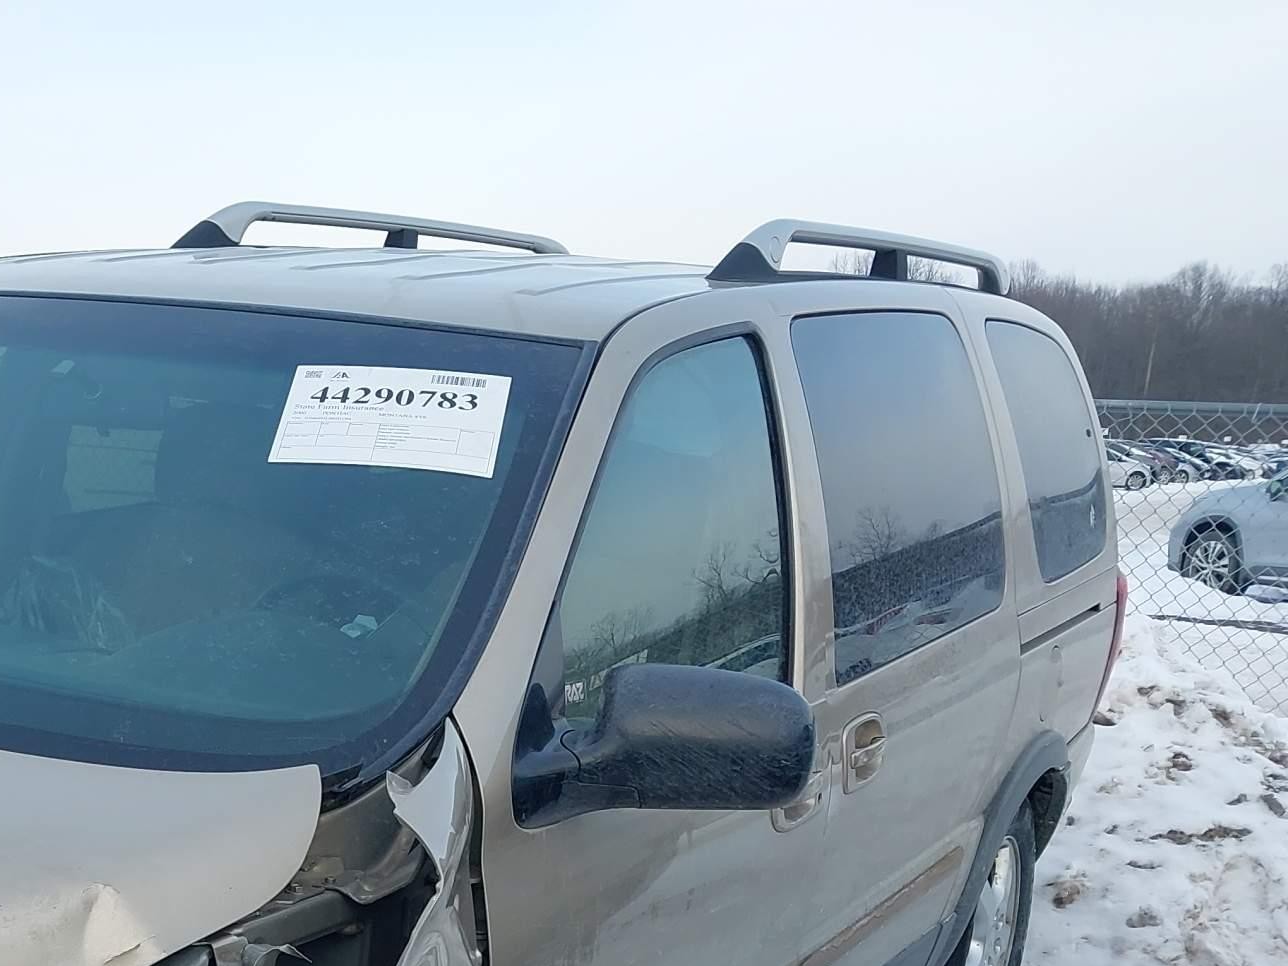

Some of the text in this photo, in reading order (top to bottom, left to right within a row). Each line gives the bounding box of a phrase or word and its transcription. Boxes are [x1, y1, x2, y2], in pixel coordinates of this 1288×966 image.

[310, 386, 479, 411] 44290783
[318, 403, 340, 411] Farm
[342, 404, 385, 412] Insurance
